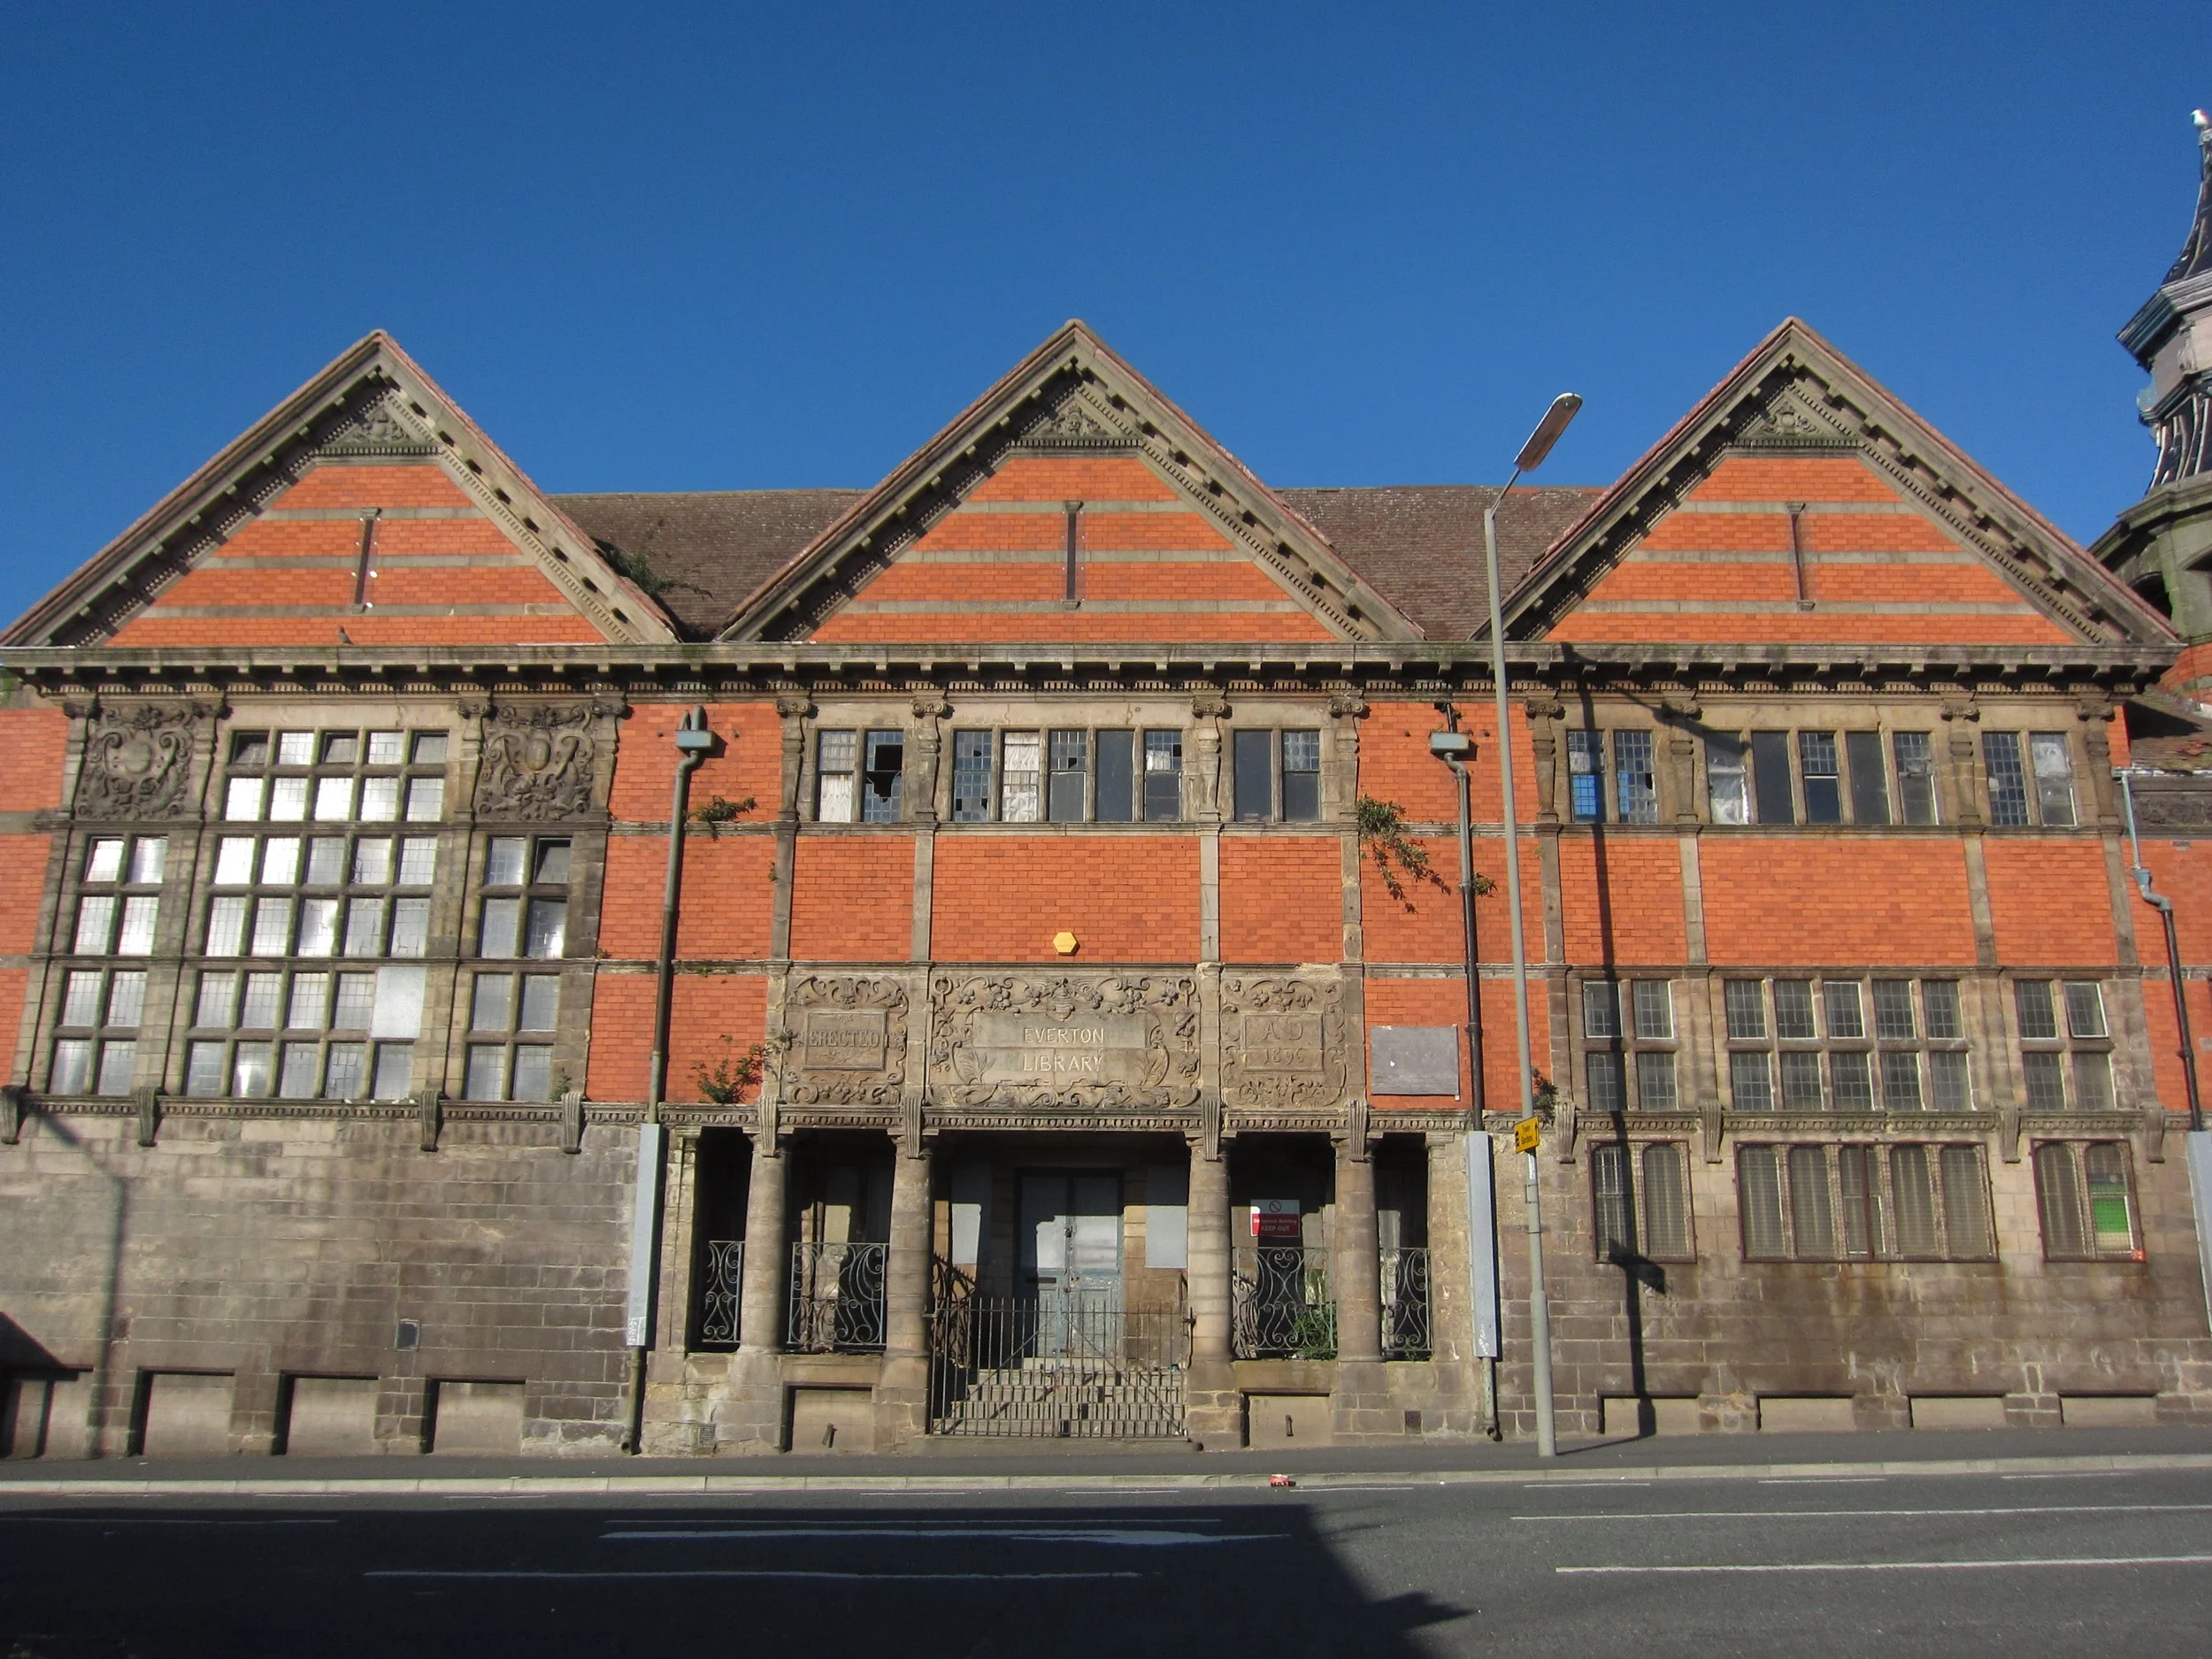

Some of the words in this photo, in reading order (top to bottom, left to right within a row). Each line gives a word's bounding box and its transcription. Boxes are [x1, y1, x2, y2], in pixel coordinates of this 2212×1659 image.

[809, 1029, 880, 1048] ERECTED
[1023, 1027, 1104, 1044] EVERTON
[1023, 1054, 1103, 1072] LIBRARY
[1263, 1048, 1304, 1065] 1896
